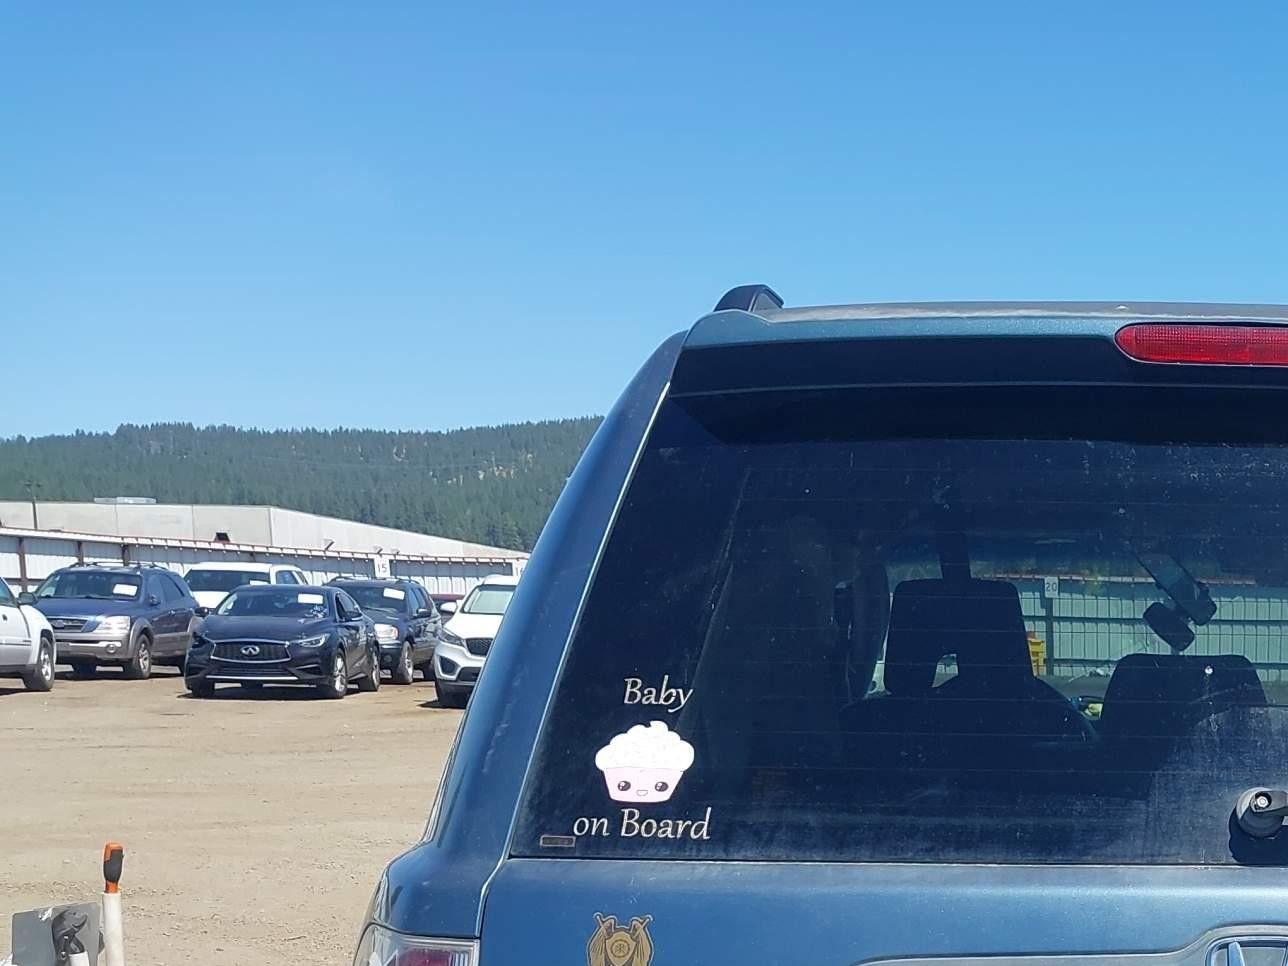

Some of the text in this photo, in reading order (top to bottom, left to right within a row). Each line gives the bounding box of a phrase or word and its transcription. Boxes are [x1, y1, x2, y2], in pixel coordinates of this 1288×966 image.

[1046, 582, 1057, 592] 20
[624, 675, 693, 712] Baby
[573, 807, 711, 839] on Board
